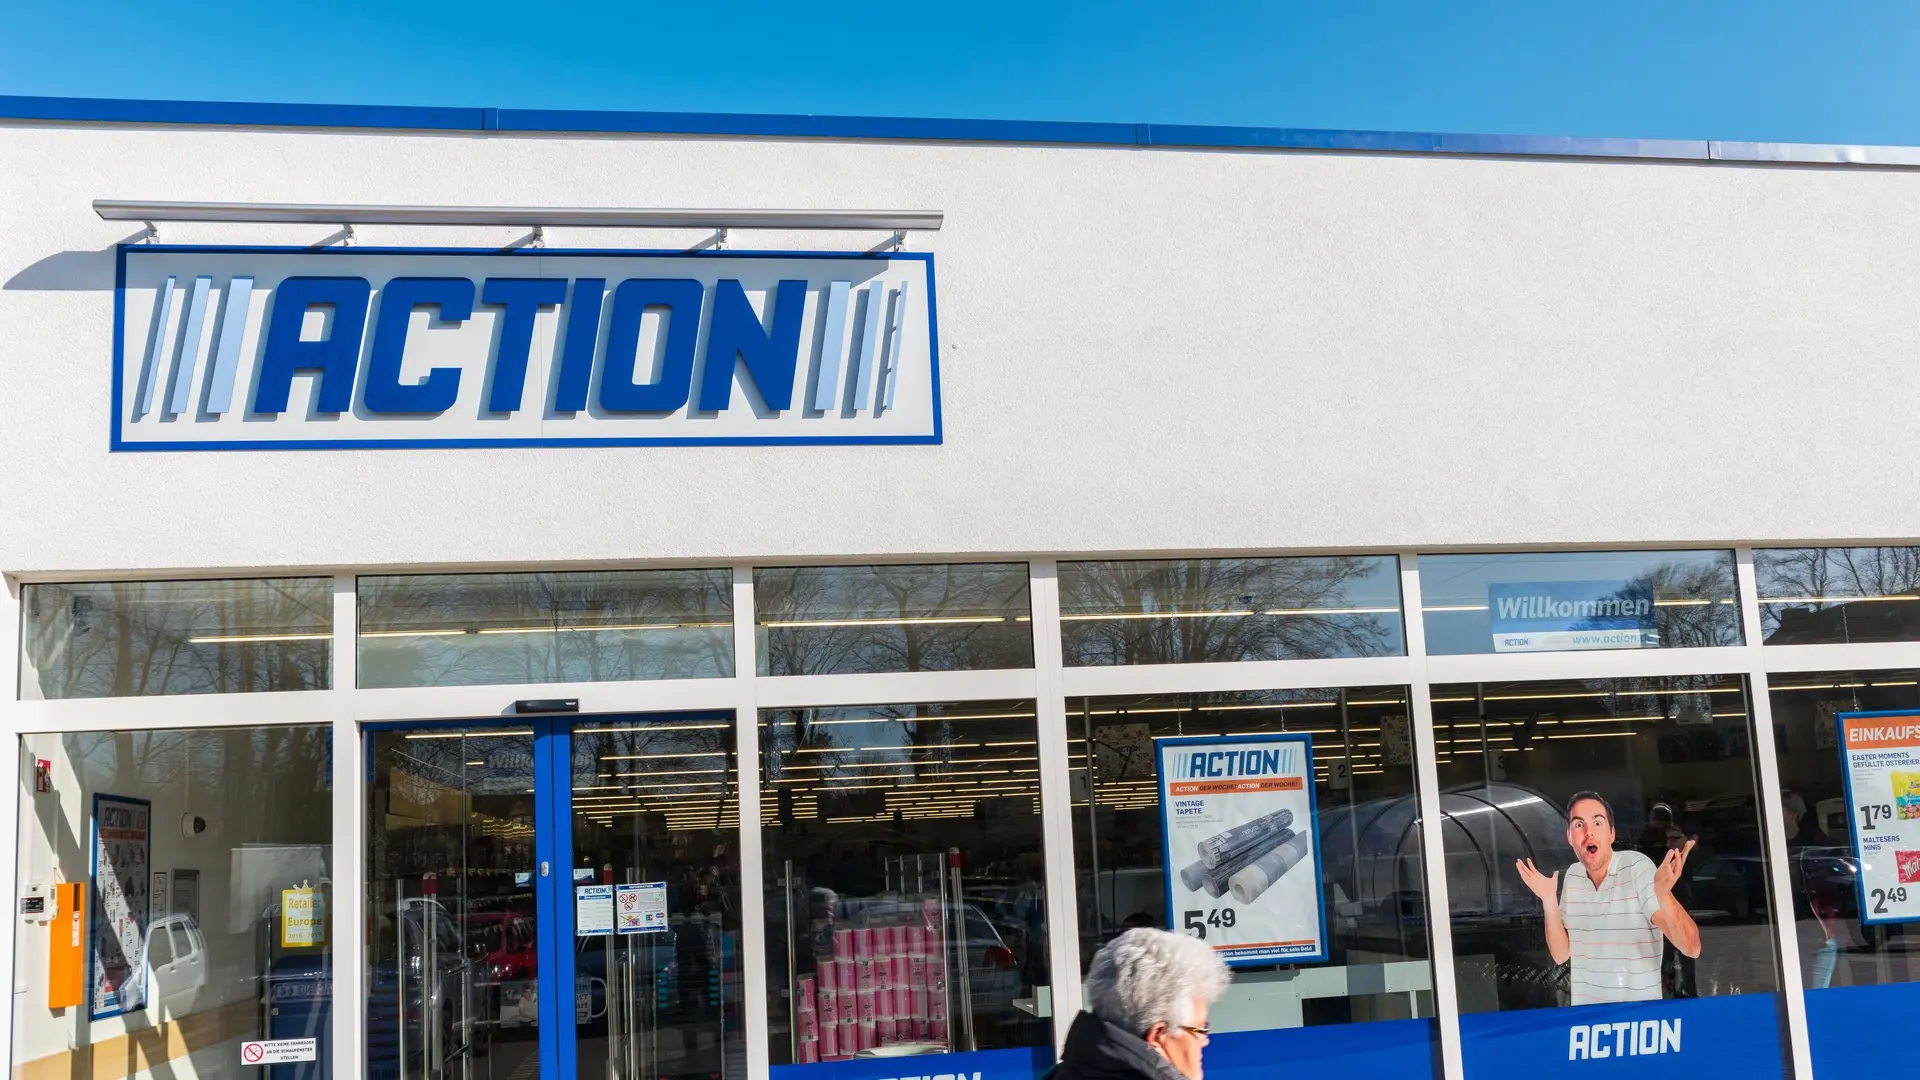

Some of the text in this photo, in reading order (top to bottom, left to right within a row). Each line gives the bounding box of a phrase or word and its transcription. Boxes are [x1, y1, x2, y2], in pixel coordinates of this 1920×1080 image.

[254, 276, 808, 414] ACTION
[1497, 596, 1649, 619] Willkommen
[1498, 756, 1504, 769] 3
[1878, 752, 1909, 760] MOMENTS
[1190, 750, 1279, 777] ACTION
[1853, 760, 1884, 768] GEFÜLLTE
[1338, 765, 1346, 778] 2
[1863, 835, 1900, 843] MALTESERS
[288, 896, 321, 909] Retailer
[288, 916, 322, 927] Europe
[1569, 1018, 1681, 1060] ACTION
